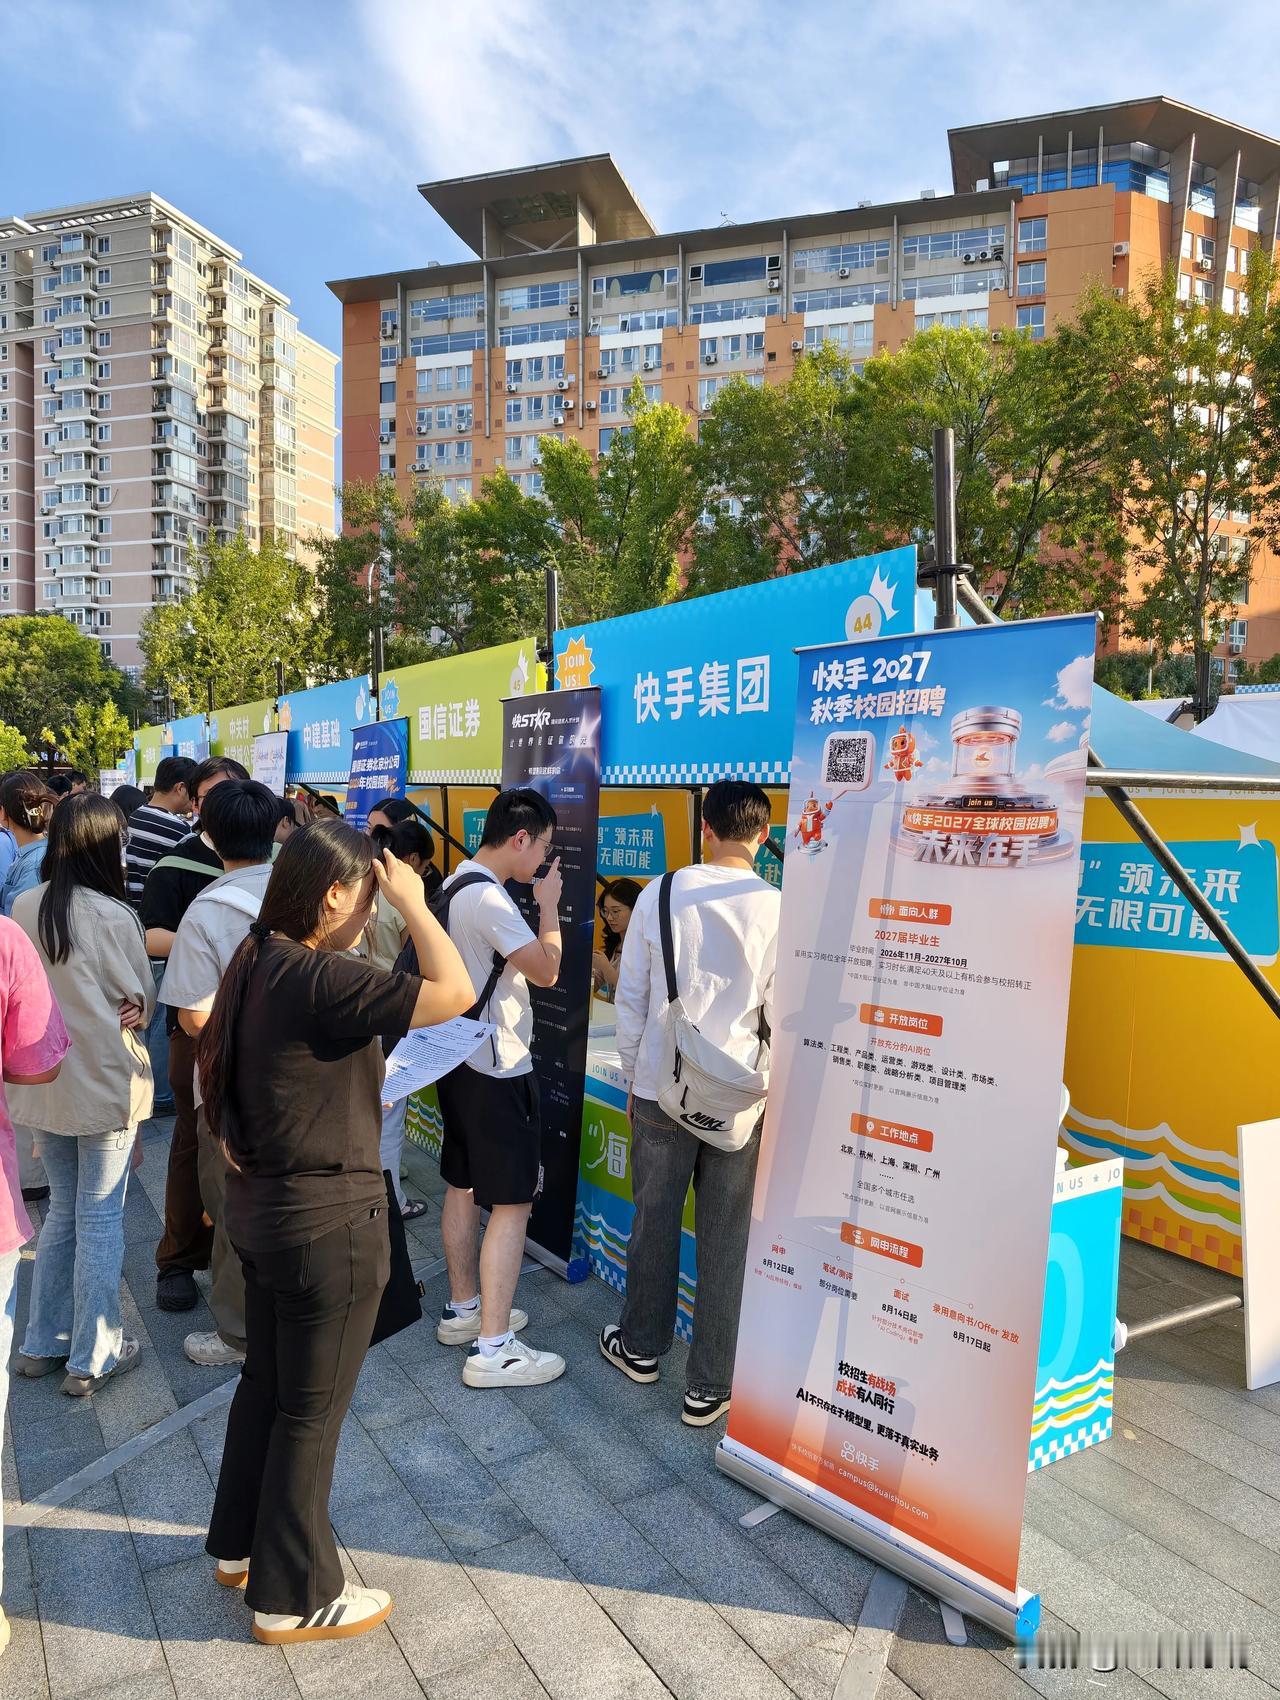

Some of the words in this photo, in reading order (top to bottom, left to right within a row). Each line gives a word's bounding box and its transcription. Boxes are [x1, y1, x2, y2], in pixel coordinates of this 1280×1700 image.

[853, 612, 873, 633] 44
[564, 653, 585, 671] JOIN
[812, 657, 868, 692] 快手
[872, 651, 931, 684] 2027
[564, 673, 581, 687] US!
[633, 655, 770, 724] 快手集团
[810, 685, 946, 725] 秋季校园招聘
[418, 698, 480, 740] 国信证券
[303, 719, 341, 750] 中建基础
[968, 799, 981, 807] join
[614, 827, 654, 848] 领未来
[600, 847, 651, 870] 无限可能
[914, 830, 1040, 868] 未来在手
[898, 904, 939, 920] 面向人群
[874, 929, 940, 947] 2027届毕业生
[889, 1013, 928, 1030] 开放岗位
[870, 1037, 931, 1057] 开放充分的AI岗位
[592, 1064, 607, 1076] JOIN
[609, 1071, 619, 1082] US
[689, 1112, 727, 1129] NIKE
[879, 1125, 919, 1144] 工作地点
[841, 1144, 941, 1179] 北京、杭州、上海、深圳、广州
[857, 1180, 915, 1204] 全国多个城市任选
[1069, 1177, 1083, 1190] US
[771, 1244, 786, 1255] 网申
[870, 1236, 909, 1258] 网申流程
[762, 1258, 795, 1275] 8月12日起
[822, 1262, 853, 1281] 笔试/测评
[819, 1278, 858, 1300] 部分岗位需要
[893, 1288, 910, 1303] 面试
[881, 1303, 918, 1324] 8月14日起
[932, 1303, 999, 1336] 录用意向书/Offer
[1001, 1329, 1020, 1344] 发放
[953, 1331, 991, 1352] 8月17日起
[838, 1360, 897, 1398] 校招生有战场
[836, 1379, 895, 1416] 成长有人同行
[856, 1450, 880, 1473] 快手
[838, 1467, 929, 1520] campus@kuaishou.com
